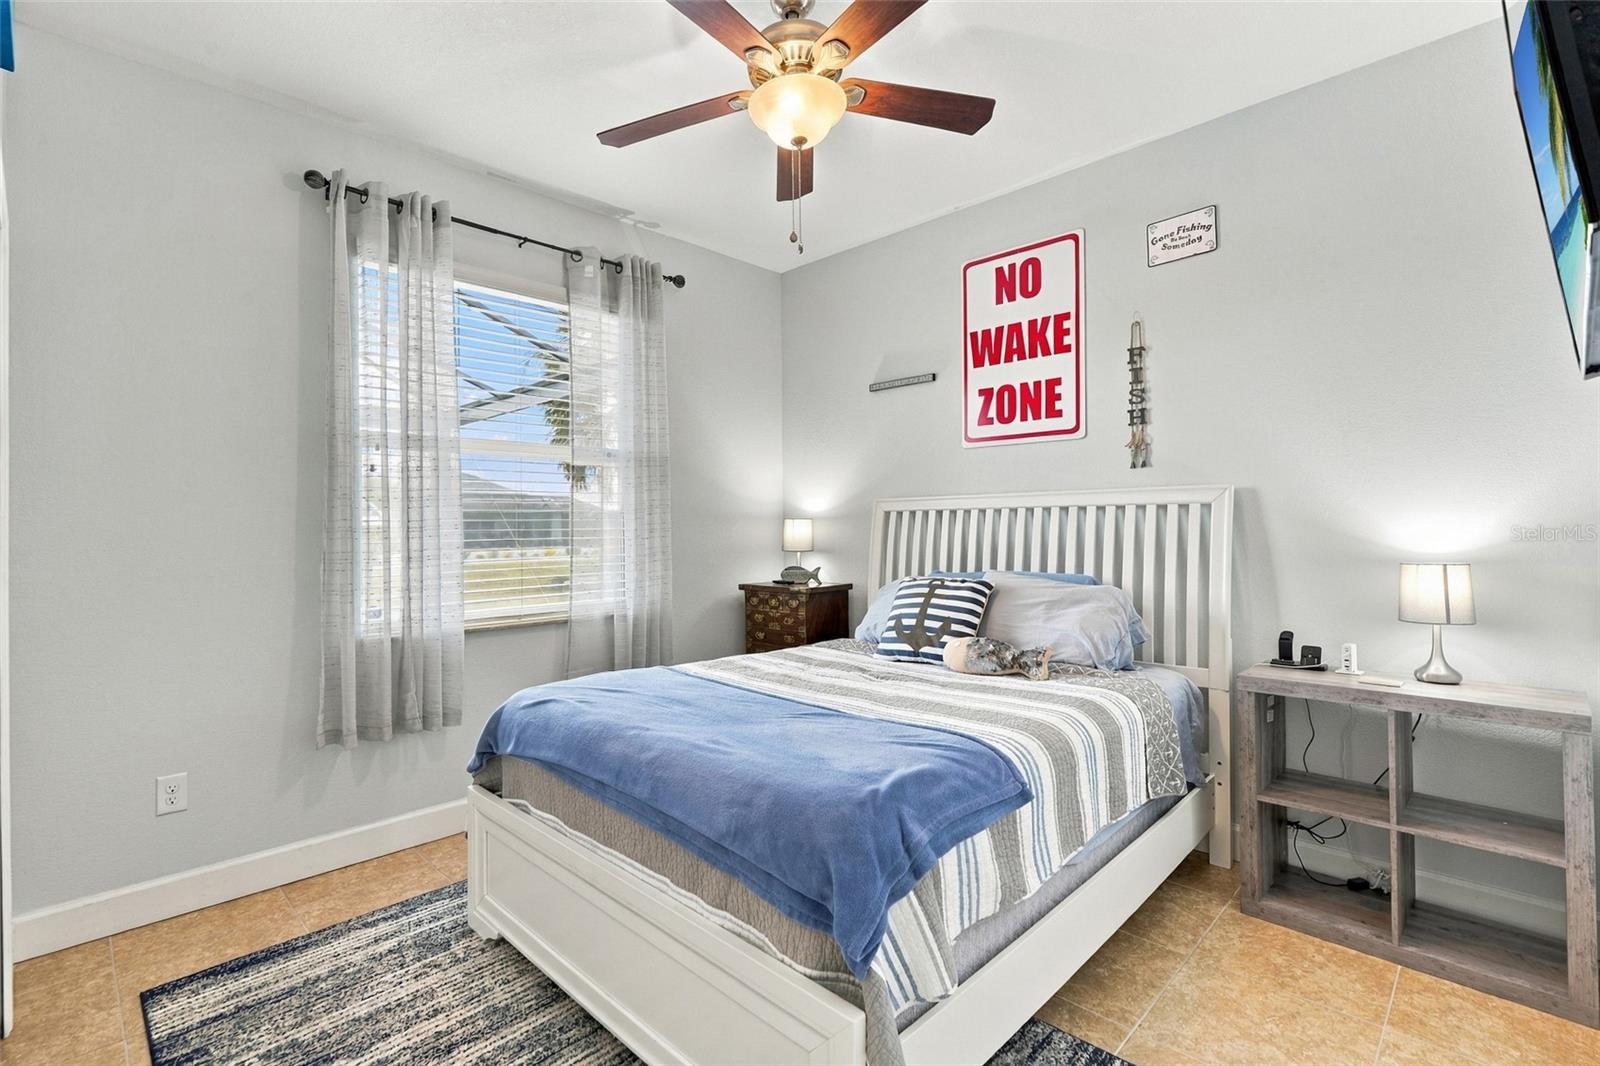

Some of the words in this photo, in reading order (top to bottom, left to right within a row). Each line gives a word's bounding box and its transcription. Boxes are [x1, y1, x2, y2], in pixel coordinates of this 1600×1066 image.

[1151, 231, 1175, 246] Gone
[1176, 222, 1213, 236] Fishing
[1161, 234, 1203, 251] Someday
[995, 256, 1042, 306] NO
[969, 311, 1072, 369] WAKE
[977, 376, 1063, 427] ZONE
[1127, 346, 1148, 426] FISH
